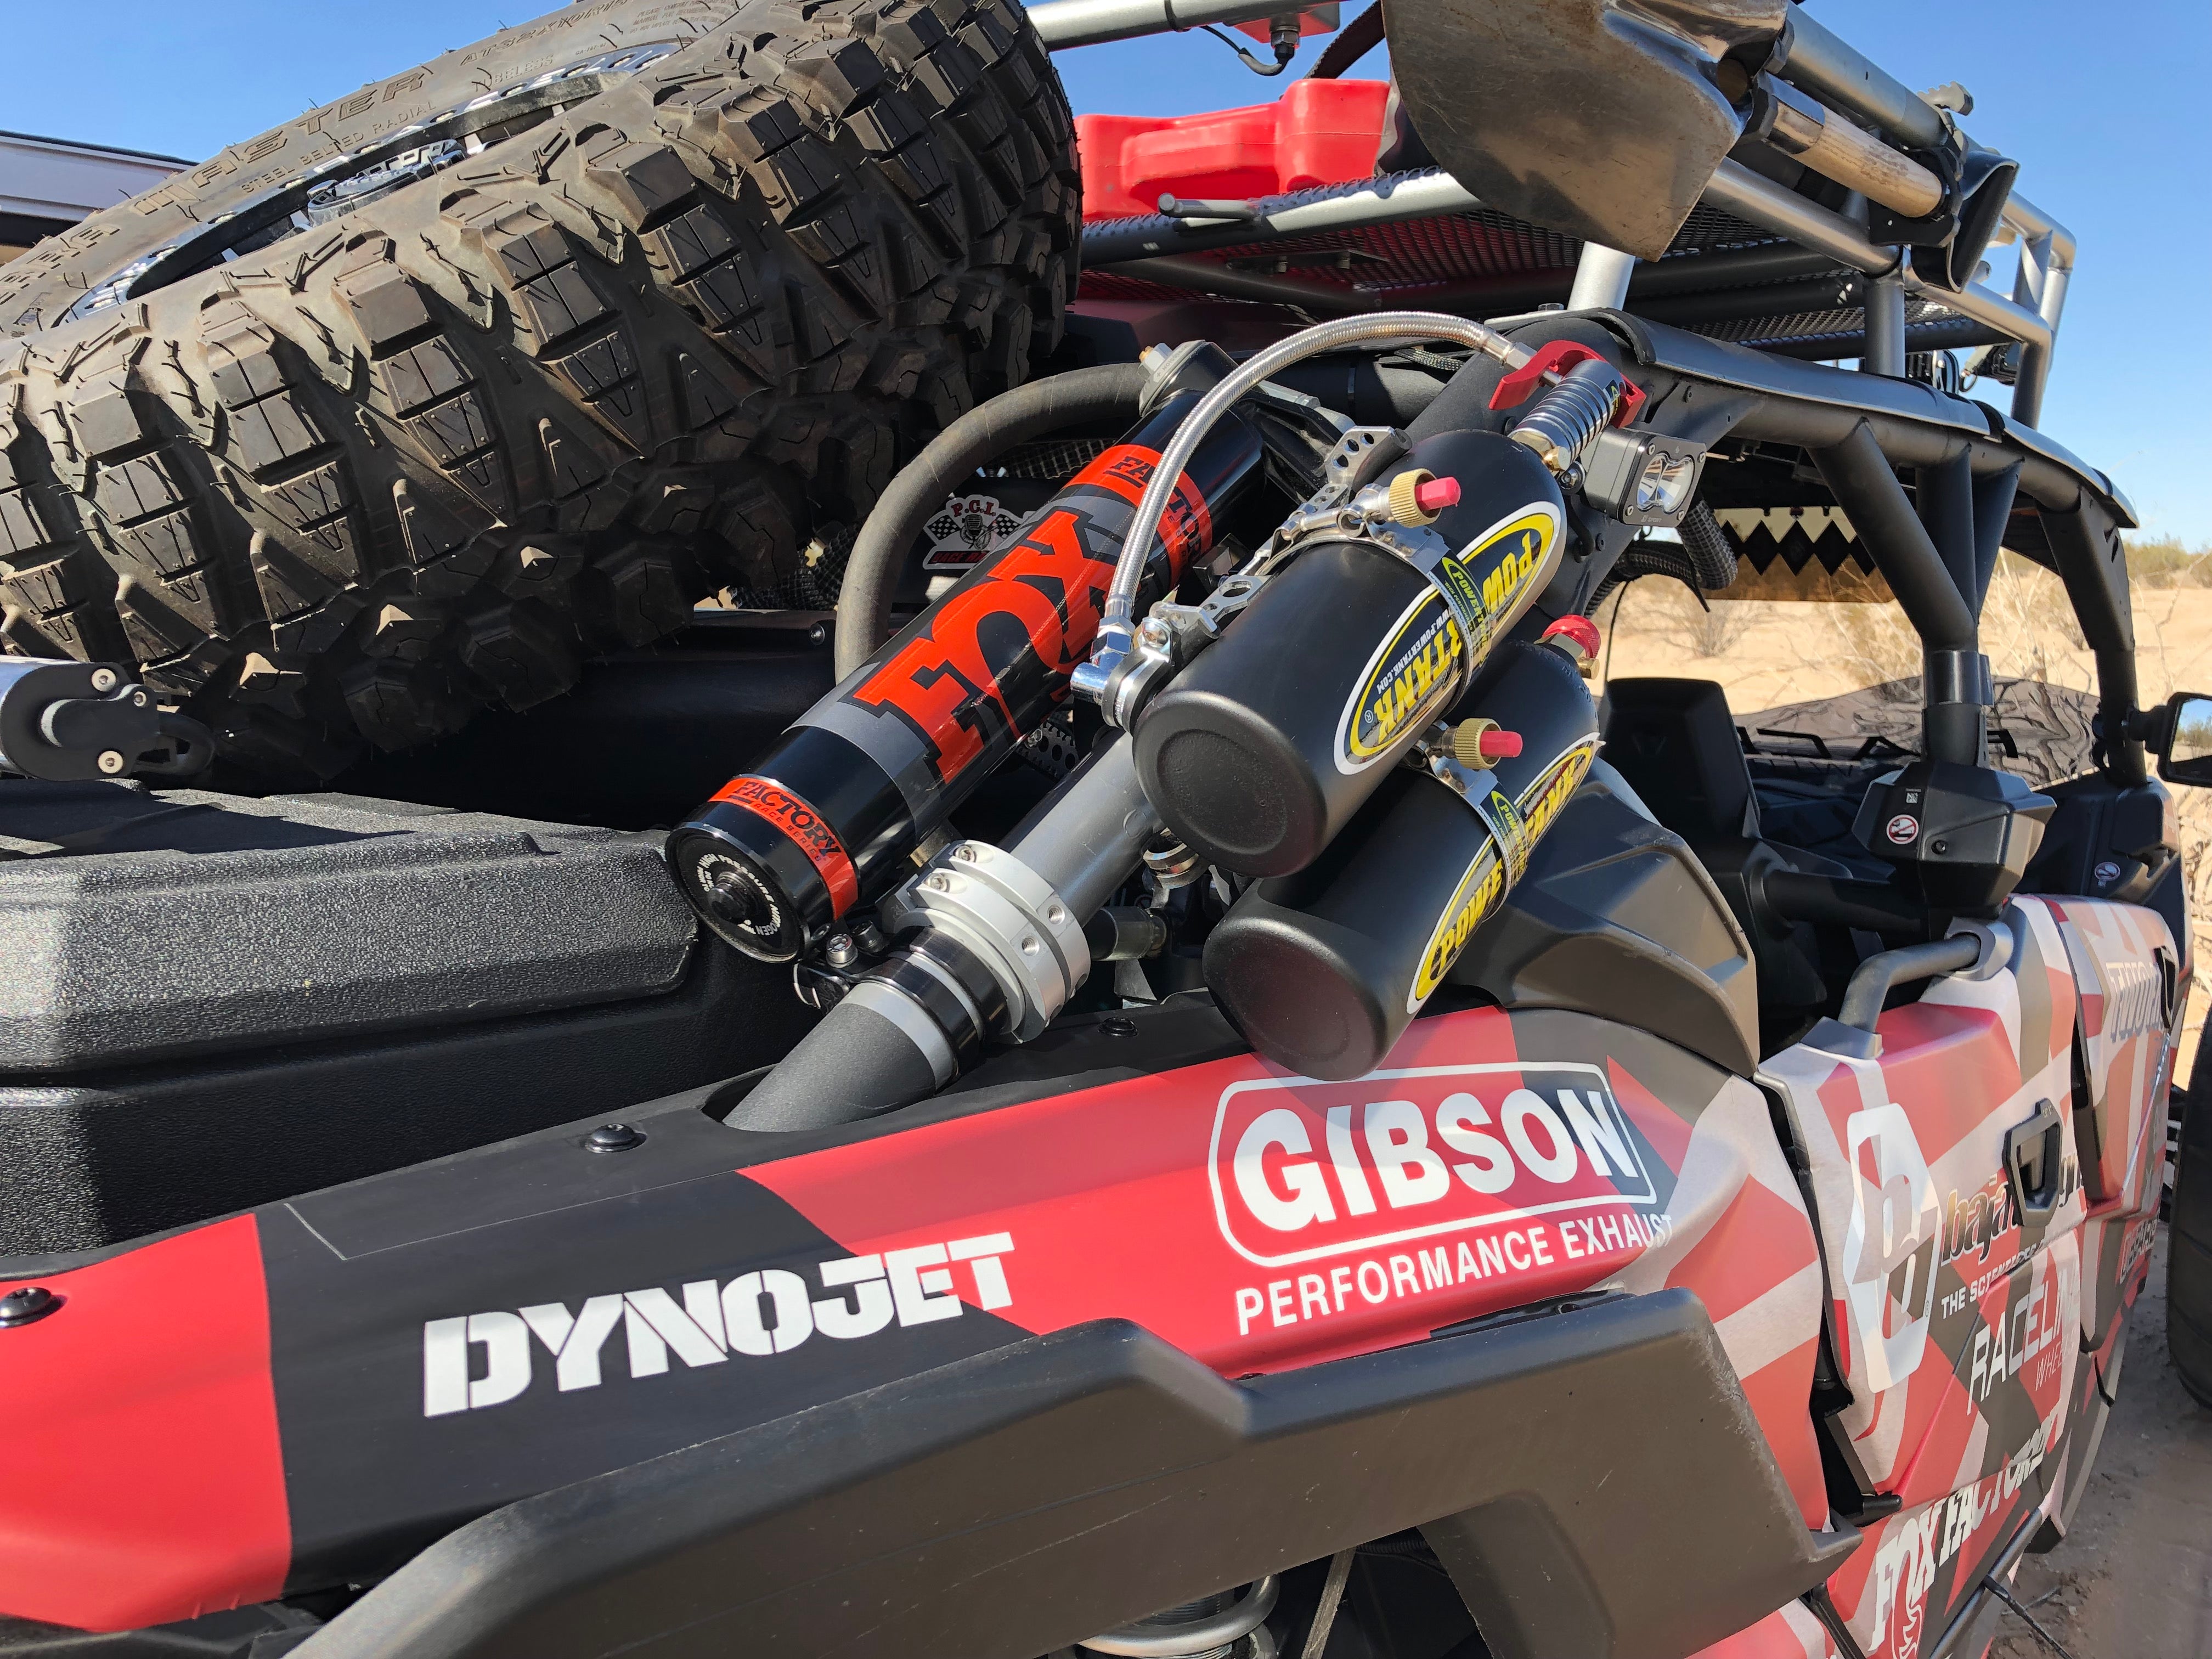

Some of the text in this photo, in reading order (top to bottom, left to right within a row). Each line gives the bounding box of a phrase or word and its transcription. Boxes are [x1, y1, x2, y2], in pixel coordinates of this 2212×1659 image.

[134, 72, 425, 215] MASTER
[241, 165, 295, 194] STEEL
[299, 132, 365, 166] BELTED
[372, 101, 436, 135] RADIAL
[852, 509, 1118, 786] FOX
[698, 853, 719, 868] HIGH
[733, 781, 842, 857] FACTORY
[753, 803, 822, 862] RACE SERIES
[1234, 1088, 1639, 1231] GIBSON
[423, 1232, 1015, 1417] DYNOJET
[1235, 1214, 1673, 1336] PERFORMANCE EXHAUST
[1941, 1286, 1966, 1317] THE
[1867, 1497, 1949, 1659] FOX
